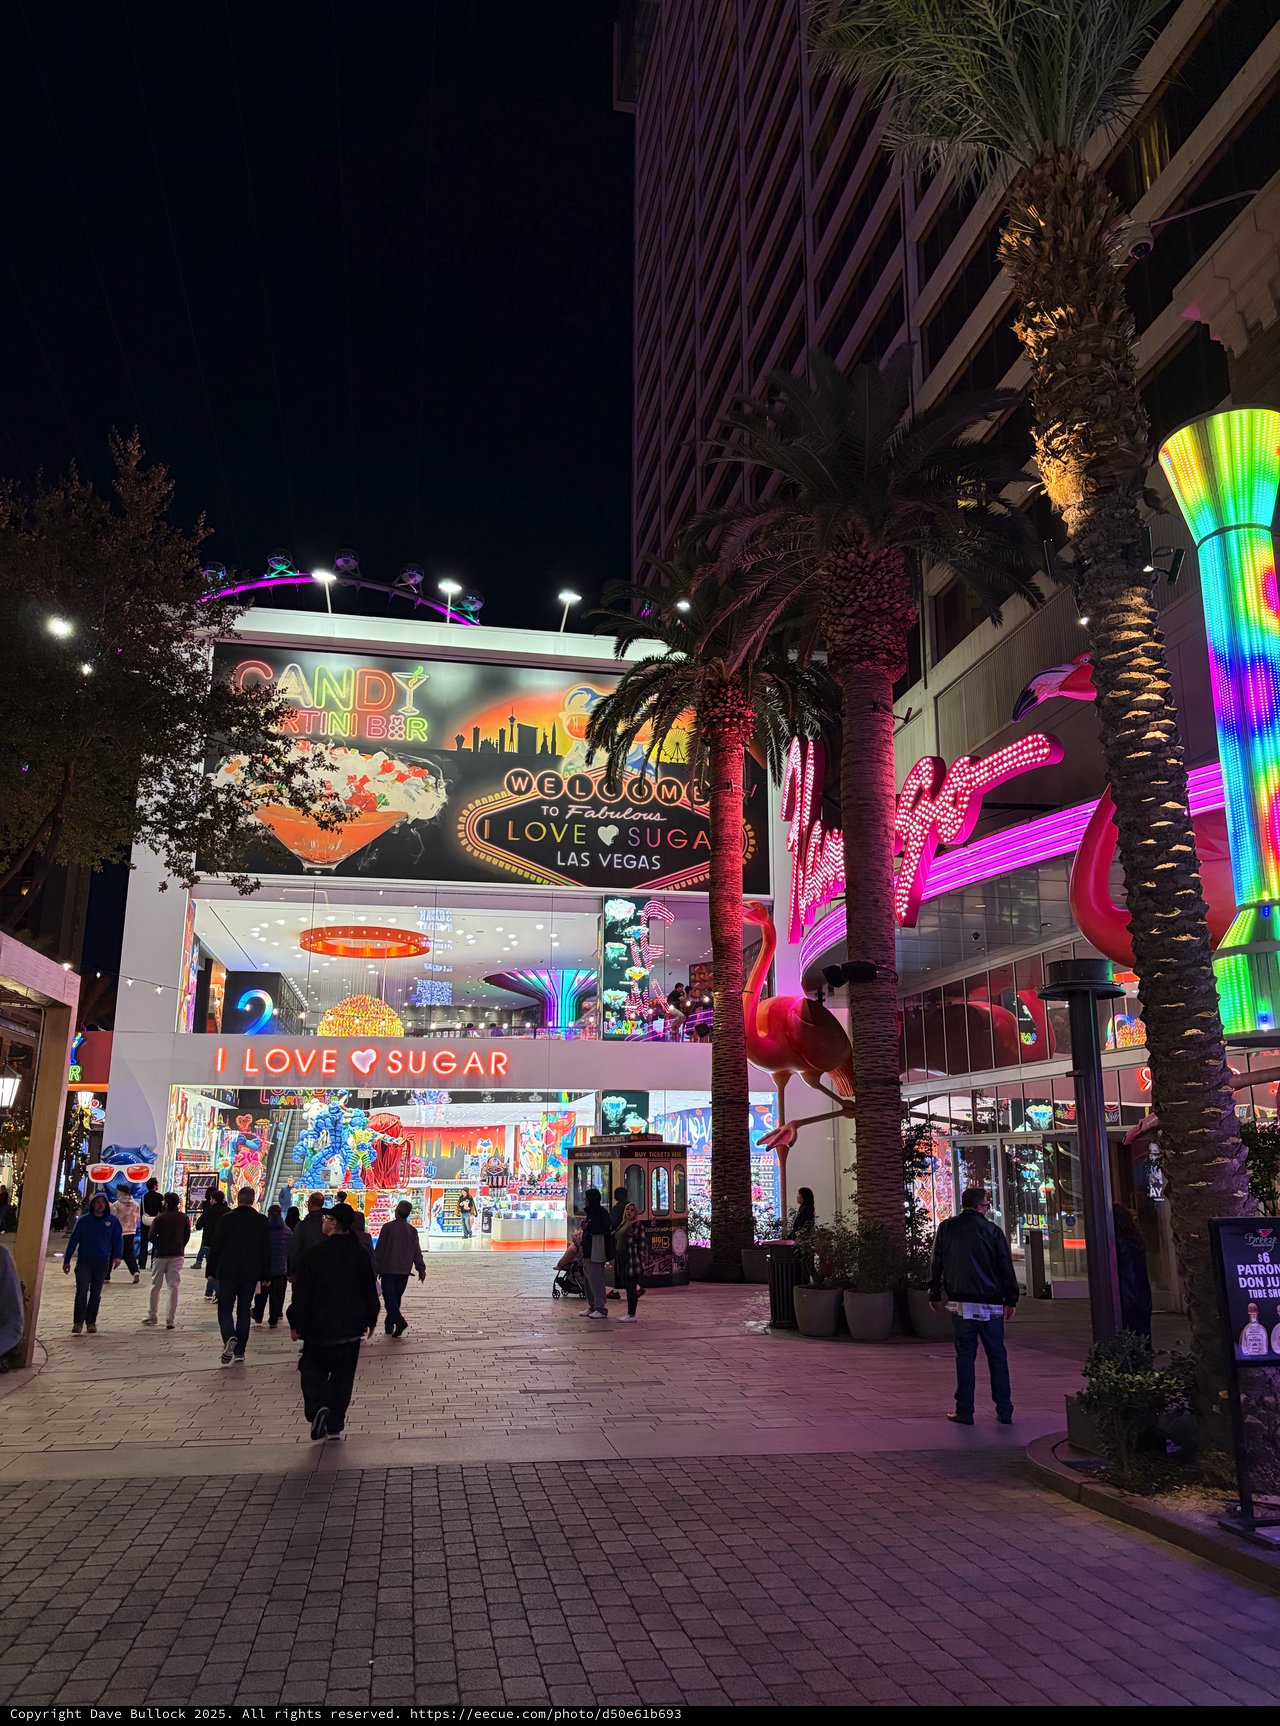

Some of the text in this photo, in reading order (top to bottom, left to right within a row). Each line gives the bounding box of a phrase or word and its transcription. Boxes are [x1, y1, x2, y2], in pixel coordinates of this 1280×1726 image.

[510, 775, 706, 803] WELCOME
[541, 804, 667, 821] TO Fabulous
[484, 819, 711, 850] I LOVE SUGA
[557, 850, 661, 870] LAS VEGAS
[217, 1047, 508, 1076] I LOVE SUGAR
[1244, 1232, 1278, 1250] Breeze
[1257, 1251, 1271, 1264] $6
[1238, 1276, 1280, 1288] DON JU
[1248, 1289, 1267, 1299] TUBE
